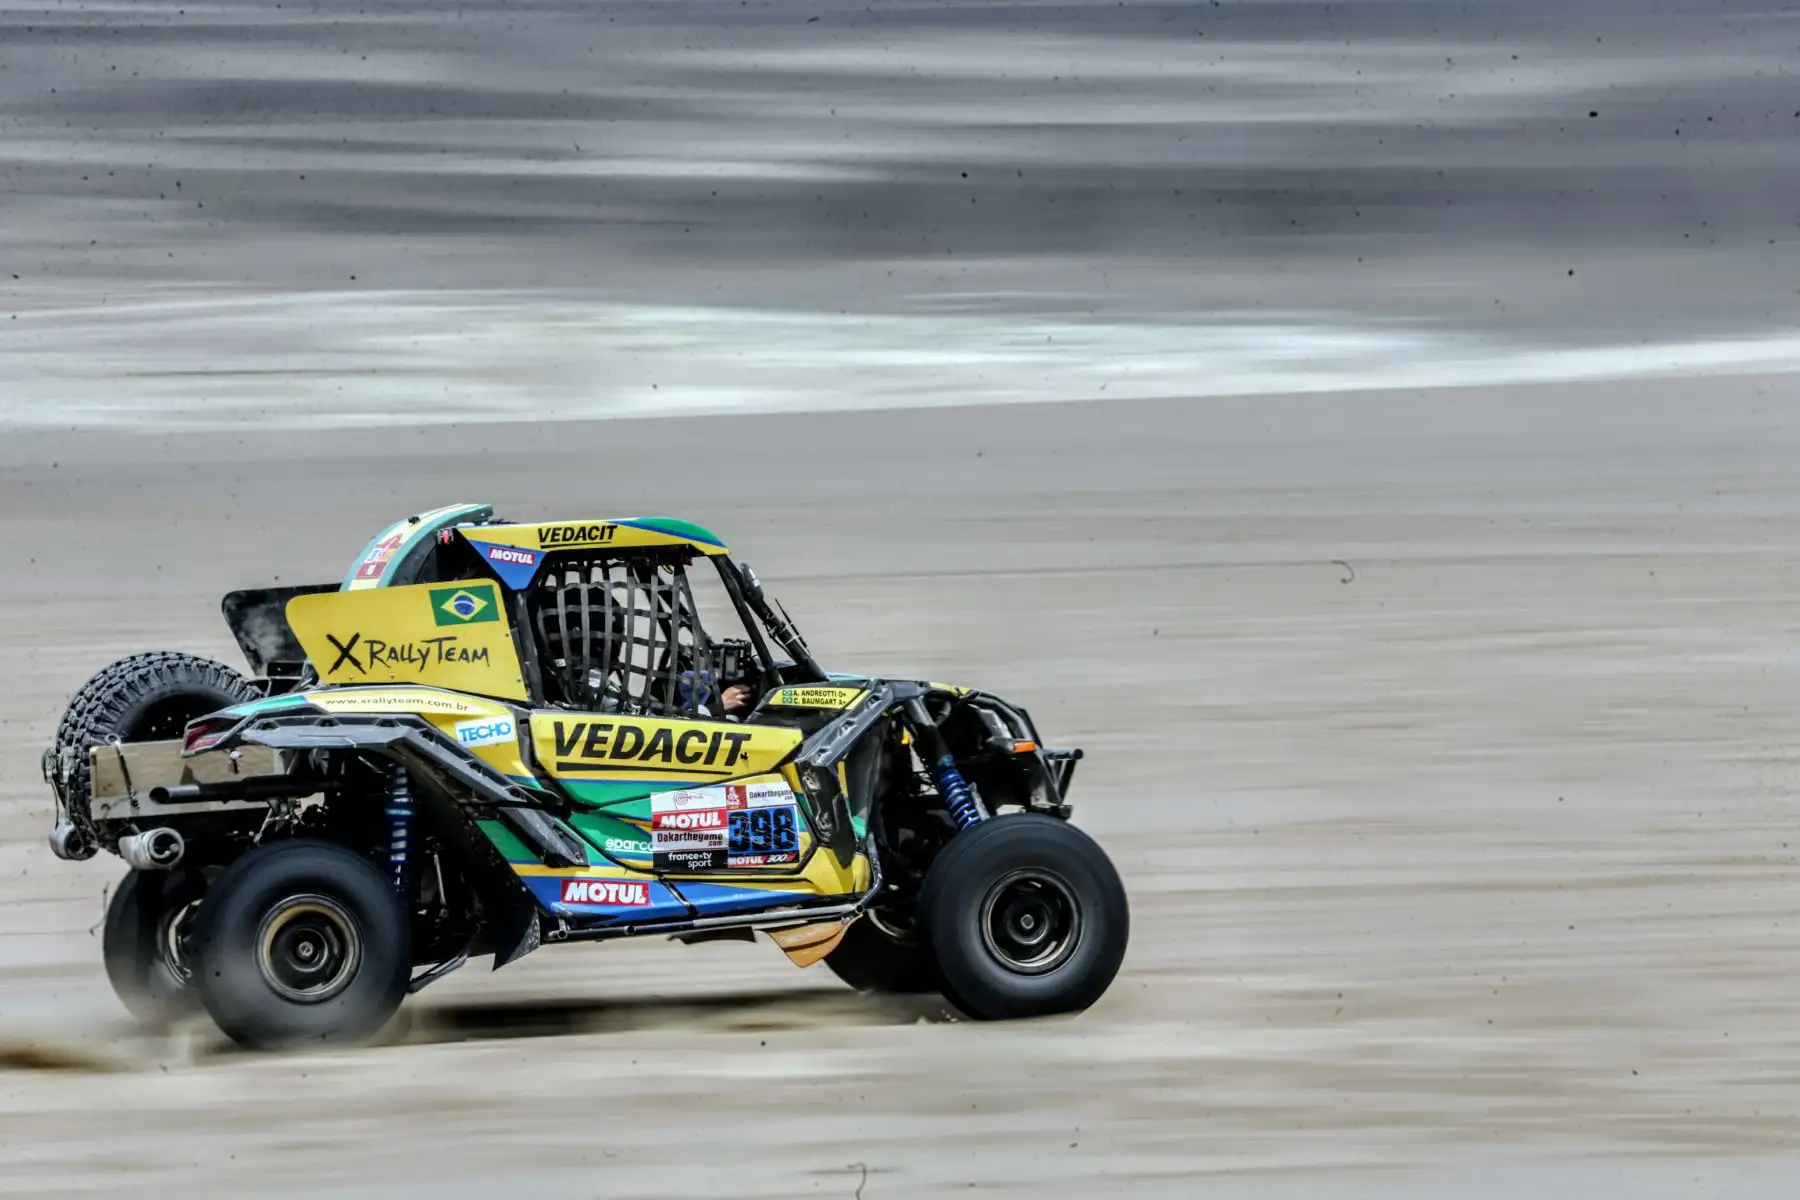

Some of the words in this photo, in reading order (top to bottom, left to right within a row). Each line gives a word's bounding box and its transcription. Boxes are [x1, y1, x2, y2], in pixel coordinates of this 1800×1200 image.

[538, 525, 618, 543] VEDACIT
[489, 548, 533, 564] MOTUL
[326, 632, 367, 675] X
[325, 696, 469, 712] www.xrallyteam.com.br
[458, 722, 511, 743] TECHO
[553, 721, 752, 767] VEDACIT
[659, 811, 722, 829] MOTUL
[657, 832, 723, 843] Dakarthegame
[728, 808, 796, 852] 398
[687, 860, 712, 870] sport
[728, 856, 764, 865] MOTUL
[564, 882, 647, 904] MOTUL
